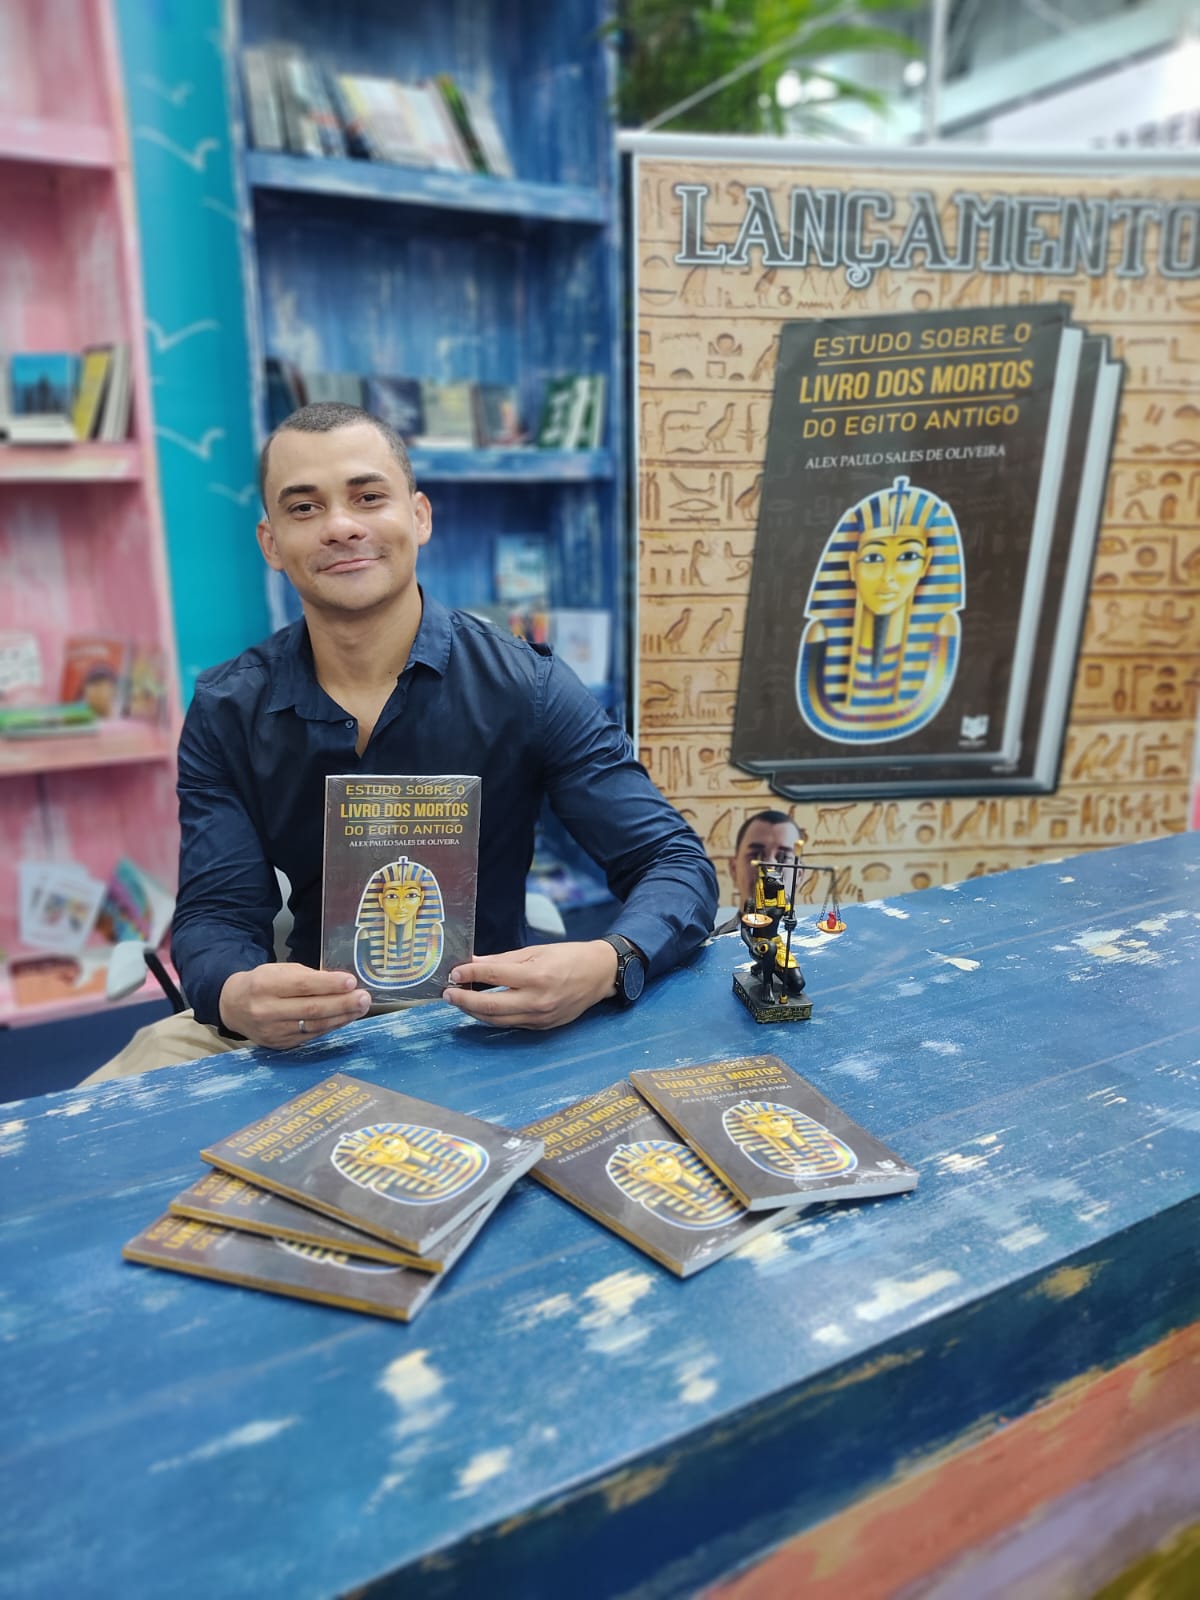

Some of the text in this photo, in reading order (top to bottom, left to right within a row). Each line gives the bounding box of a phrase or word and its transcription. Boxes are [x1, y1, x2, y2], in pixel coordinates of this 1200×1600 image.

[674, 183, 1200, 288] LANÇAMENTO
[813, 322, 1032, 358] ESTUDO SOBRE O
[799, 359, 1034, 404] LIVRO DOS MORTOS
[802, 404, 1019, 439] DO EGITO ANTIGO
[805, 445, 1005, 469] ALEX PAULO SALES DE OLIVEIRA
[346, 785, 465, 795] ESTUDO SOBRE O
[340, 803, 469, 818] LIVRO DOS MORTOS
[345, 825, 364, 836] DO
[413, 824, 463, 834] ANTIGO
[651, 1068, 705, 1079] ESTUDO
[655, 1066, 782, 1090] LIVRO DOS MORTOS
[226, 1116, 282, 1148] ESTUDO
[237, 1085, 360, 1159] LIVRO DOS MORTOS
[260, 1148, 284, 1162] DO
[325, 1093, 371, 1123] ANTIGO
[560, 1120, 590, 1137] DOS
[586, 1095, 640, 1123] MORTOS
